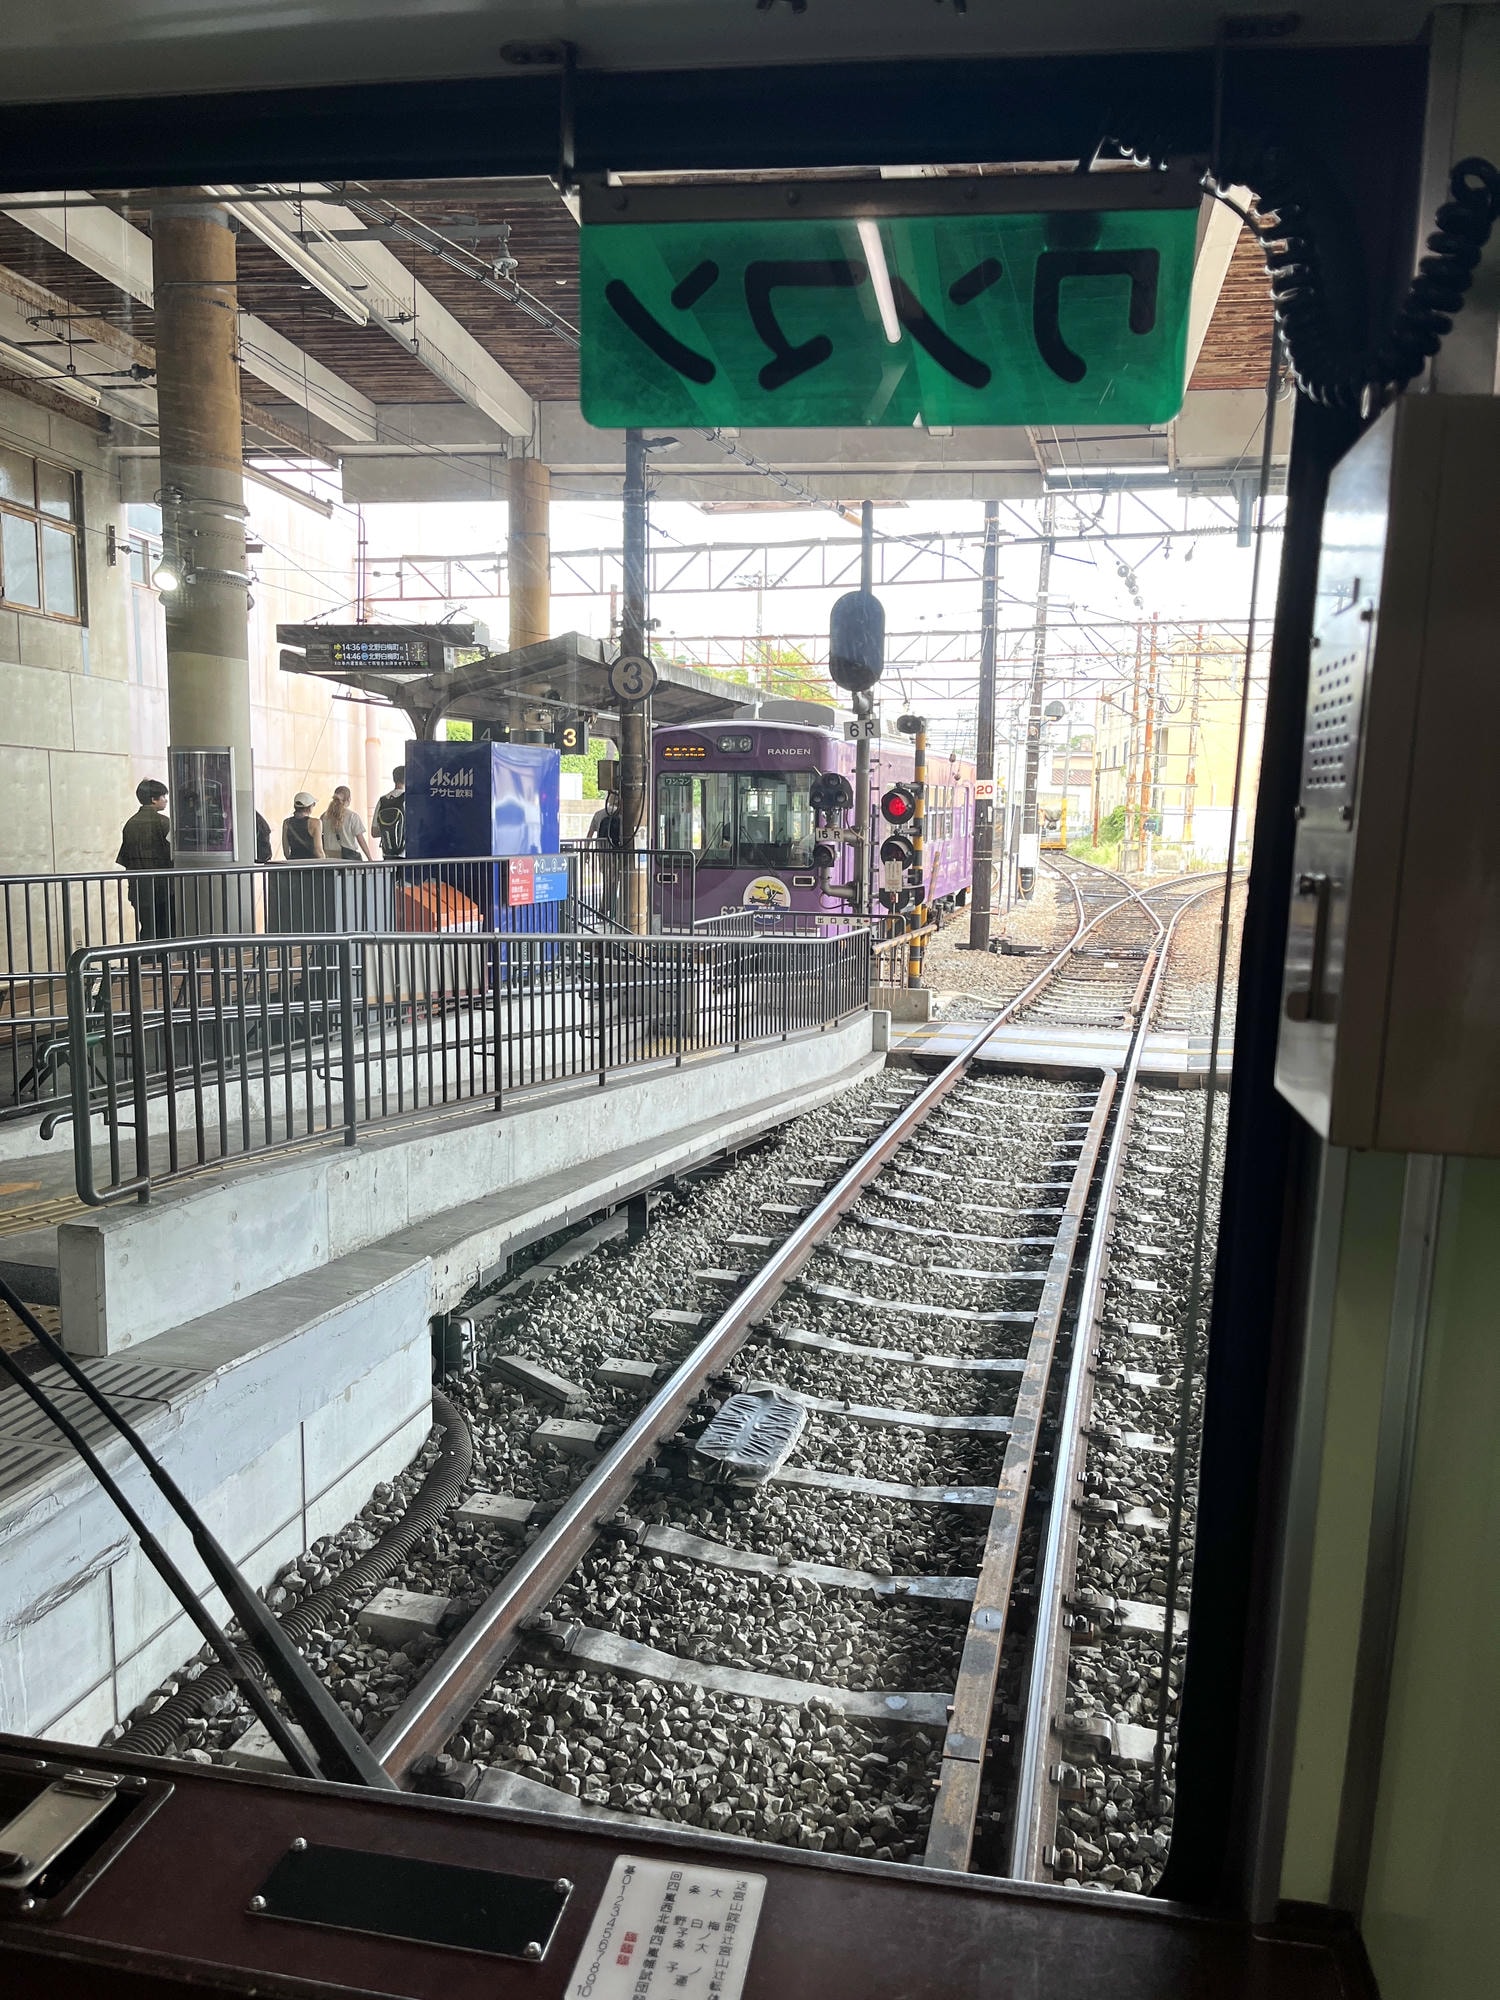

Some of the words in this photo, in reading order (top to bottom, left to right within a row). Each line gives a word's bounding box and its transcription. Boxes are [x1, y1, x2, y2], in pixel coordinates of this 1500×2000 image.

[342, 652, 361, 660] 14:46
[622, 661, 644, 694] 3
[480, 728, 493, 741] 4
[849, 722, 859, 737] 6
[864, 721, 875, 737] R
[563, 728, 577, 747] 3
[430, 767, 474, 787] Asahi
[430, 787, 473, 798] アサヒ飲料
[976, 785, 993, 795] 20
[818, 830, 829, 840] 15
[834, 830, 841, 839] R
